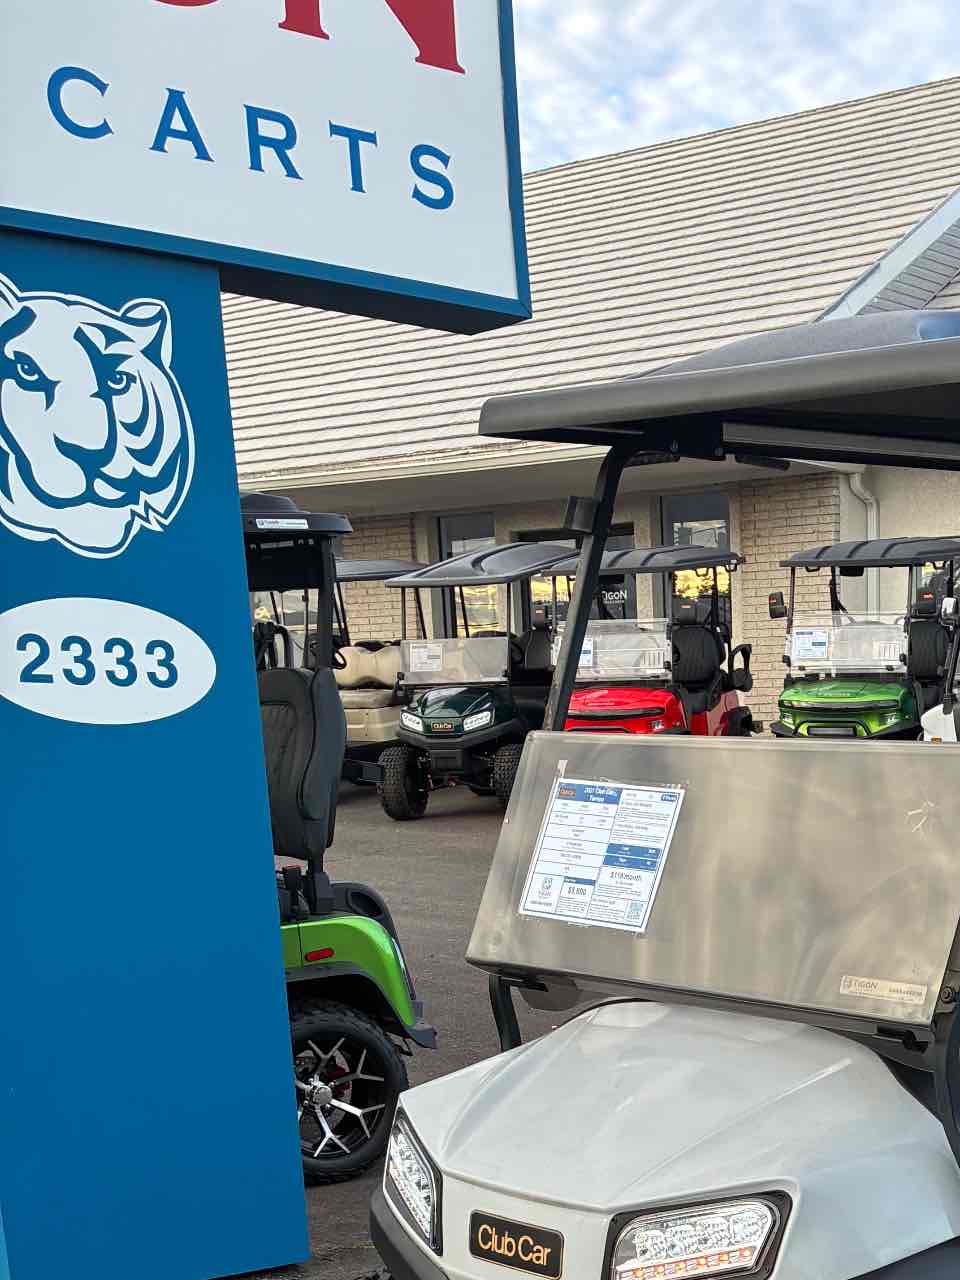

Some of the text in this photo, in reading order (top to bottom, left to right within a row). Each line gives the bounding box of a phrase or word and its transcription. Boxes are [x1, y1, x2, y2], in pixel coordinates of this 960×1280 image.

[46, 65, 456, 210] CARTS
[15, 631, 179, 689] 2333
[478, 1224, 552, 1266] Club Car
